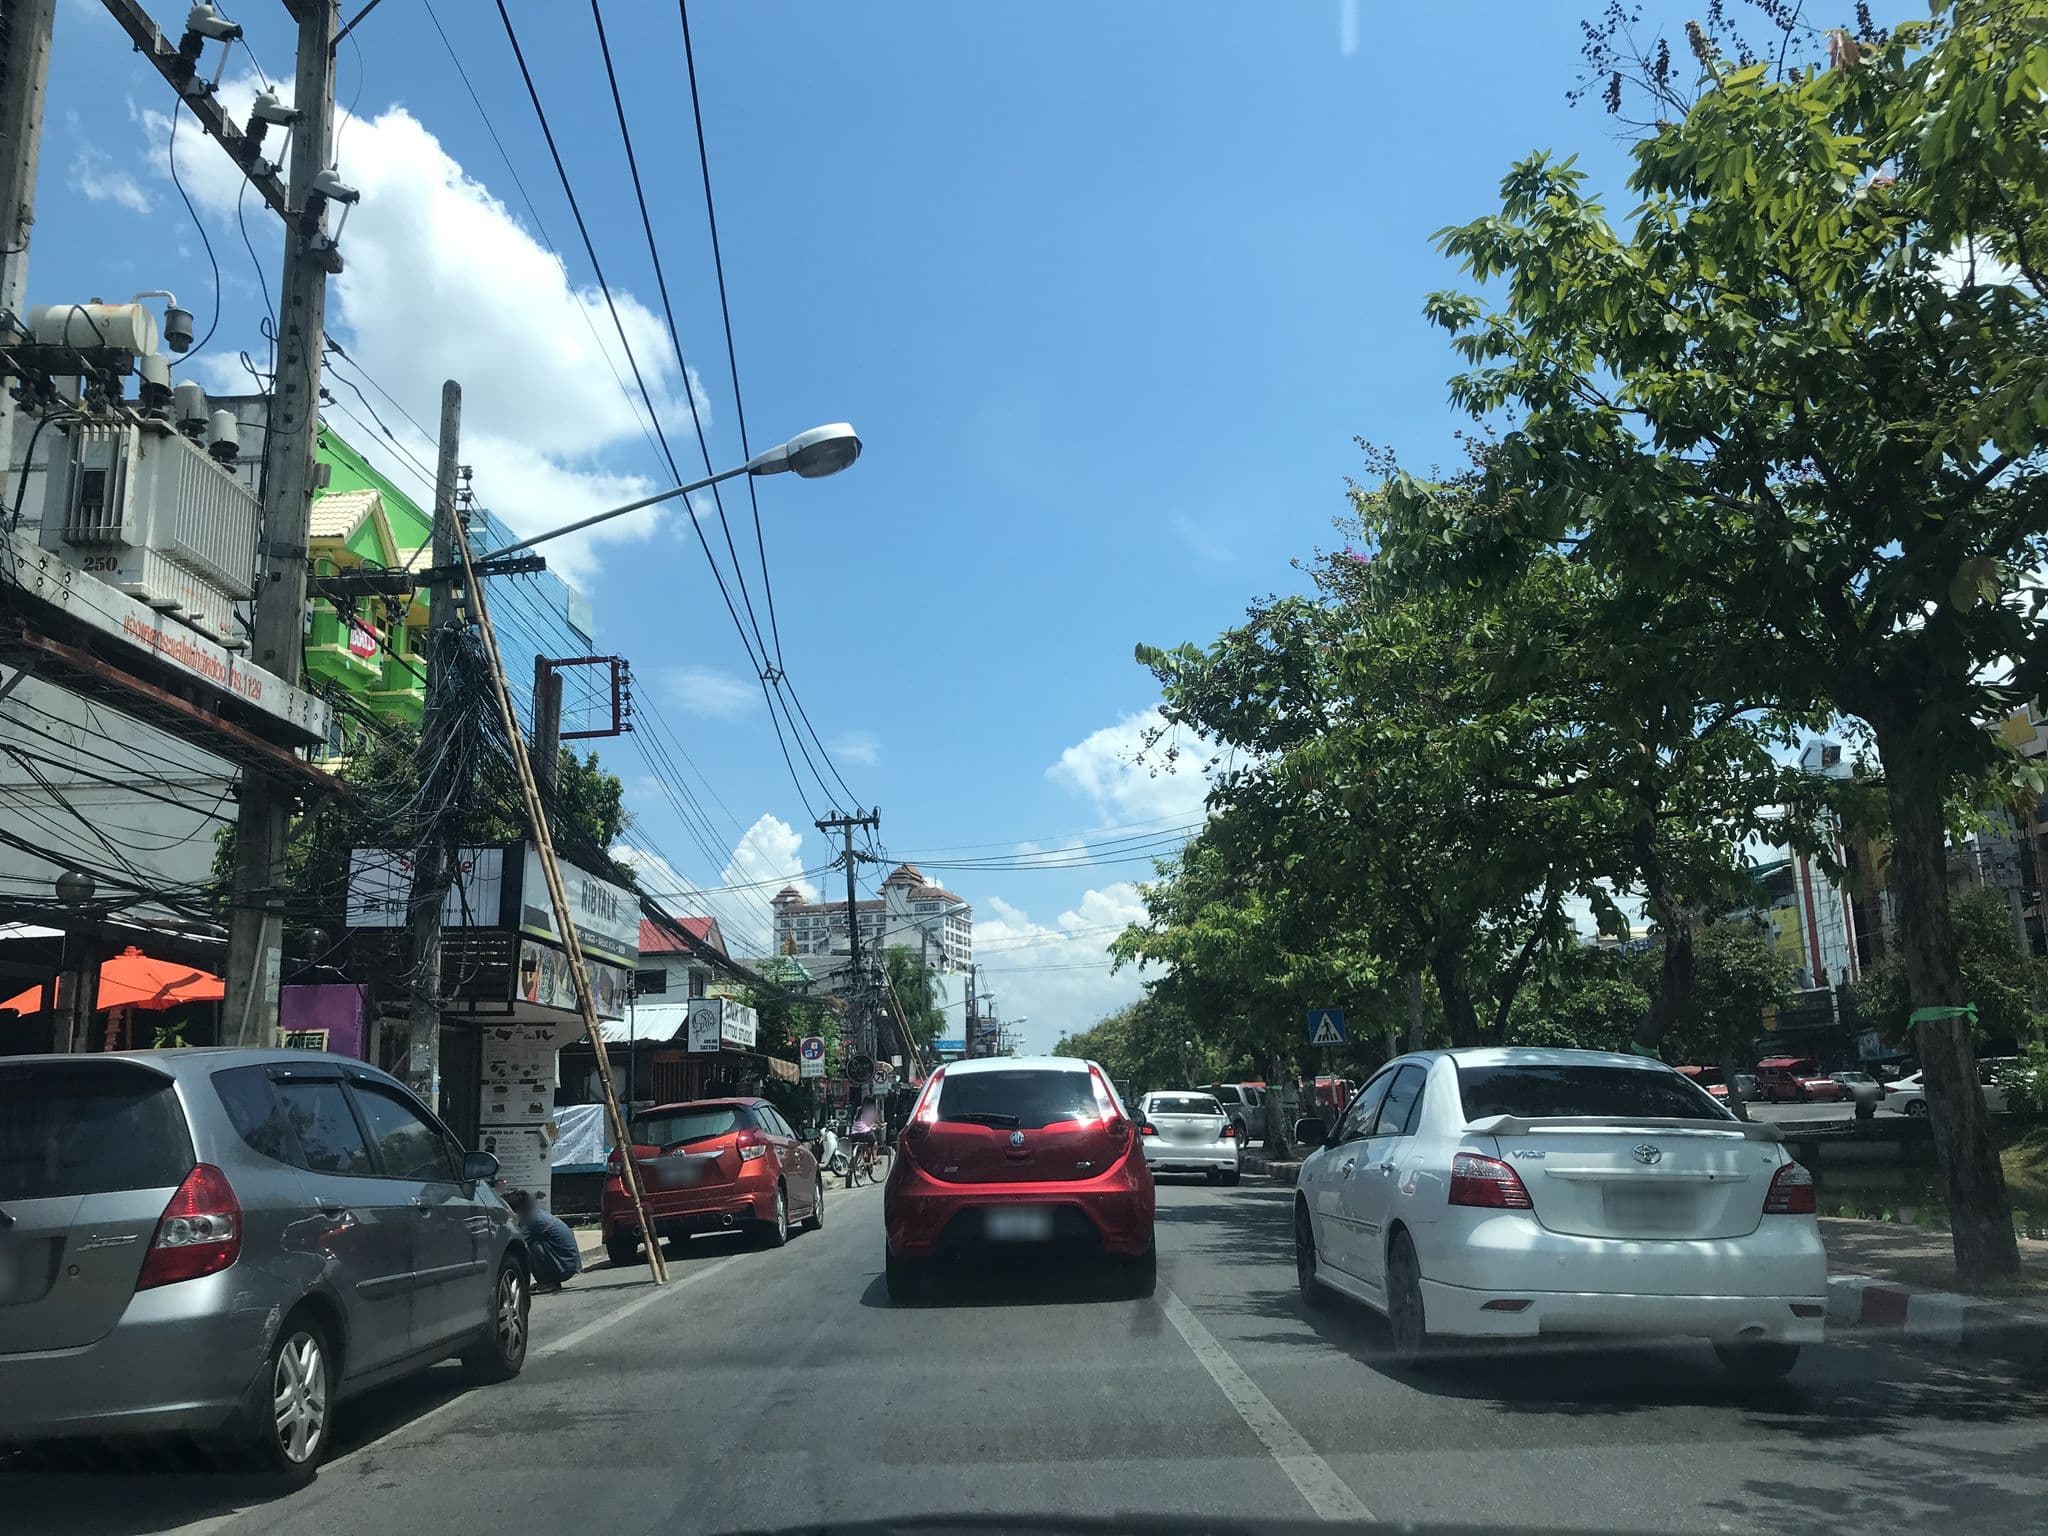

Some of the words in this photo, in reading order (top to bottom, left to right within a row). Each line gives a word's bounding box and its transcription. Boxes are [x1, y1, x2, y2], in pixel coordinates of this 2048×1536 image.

[82, 556, 118, 572] 250
[581, 880, 618, 924] RIBTALK
[723, 1022, 738, 1040] TATTOO
